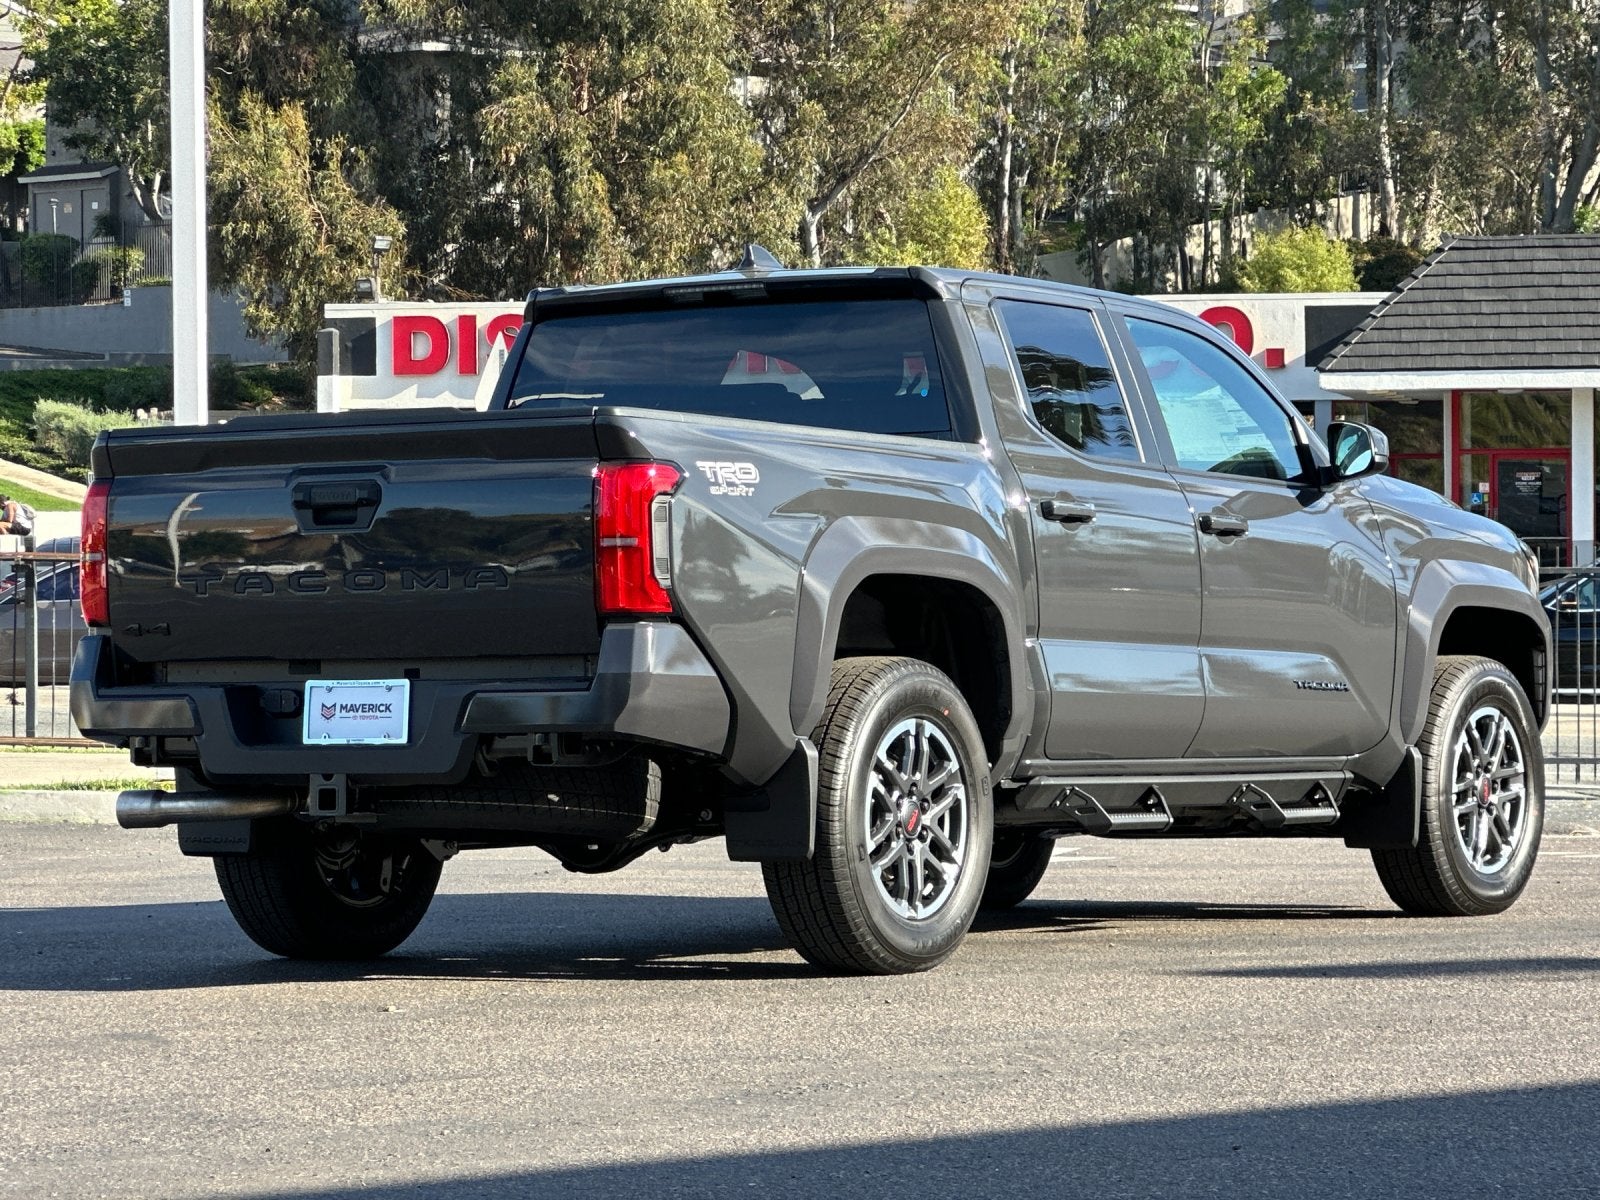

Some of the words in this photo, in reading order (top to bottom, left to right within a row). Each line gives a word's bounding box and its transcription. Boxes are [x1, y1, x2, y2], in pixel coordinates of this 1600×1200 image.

[695, 461, 760, 484] TRD
[709, 485, 755, 496] SPORT
[181, 566, 510, 597] TACOMA
[1293, 680, 1349, 692] TACOMA
[339, 703, 392, 713] MAVERICK
